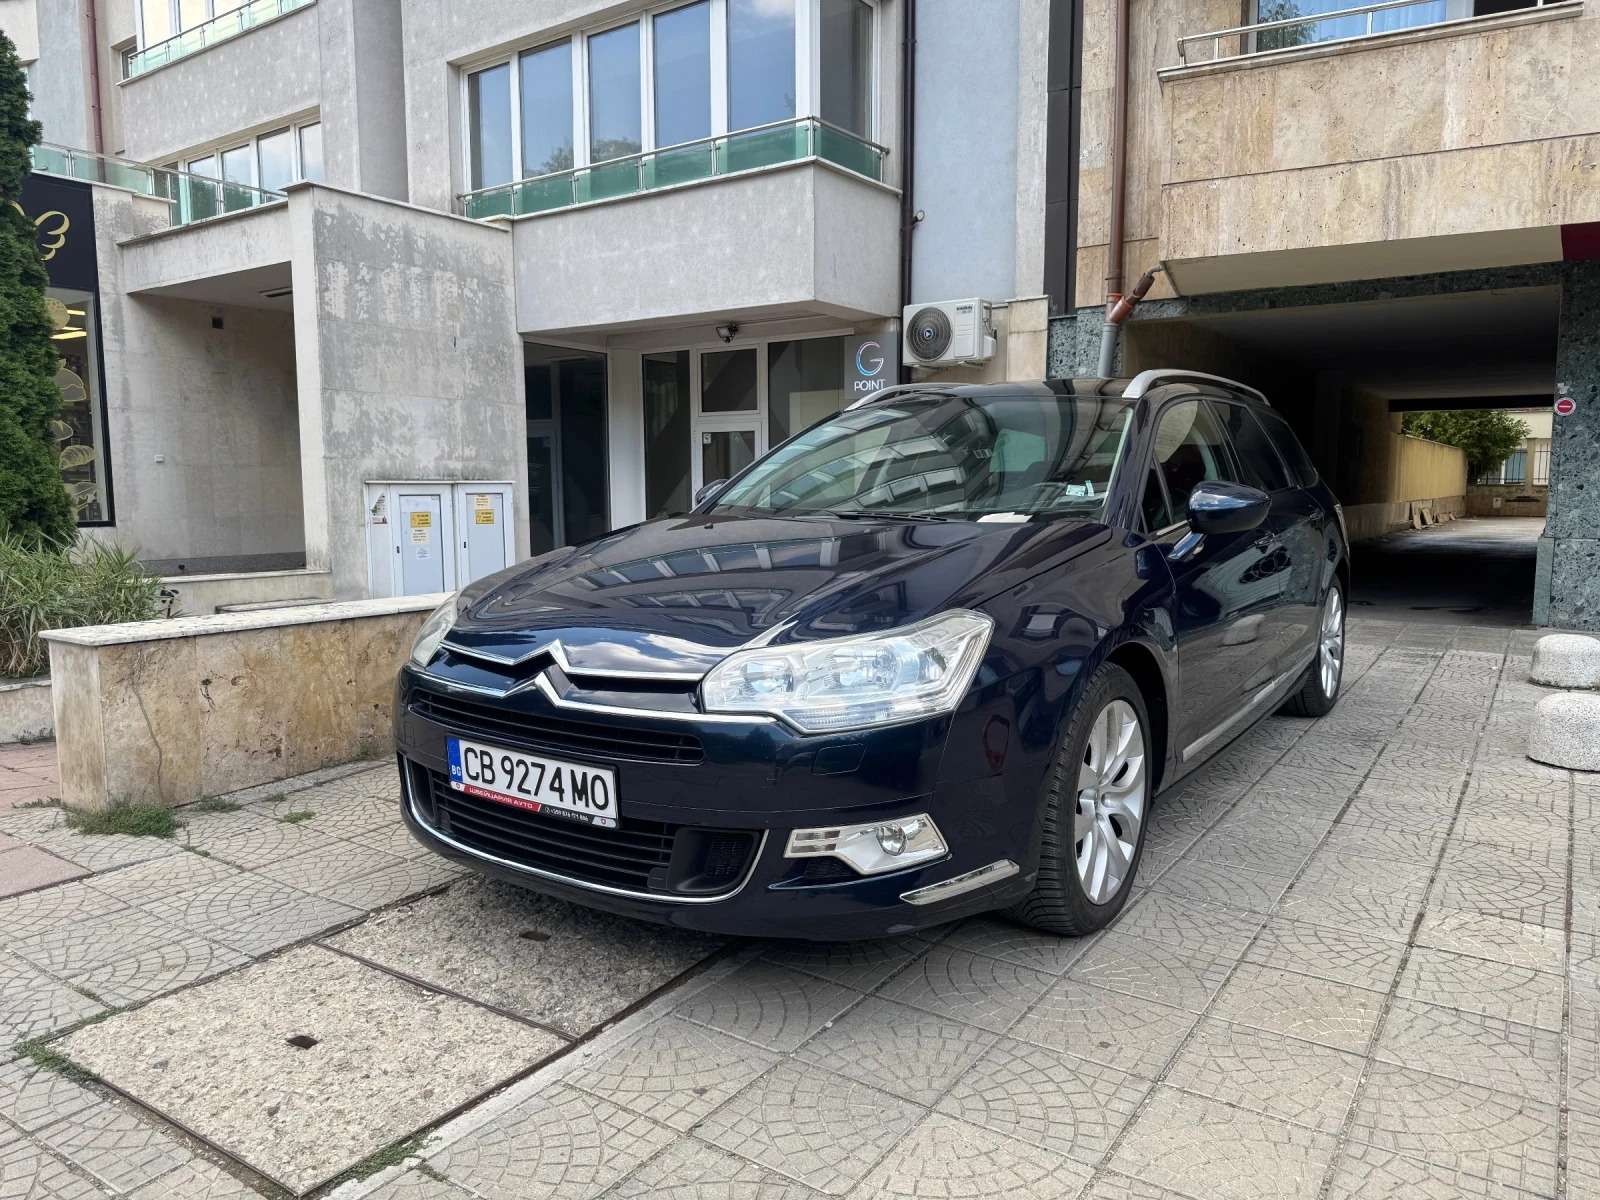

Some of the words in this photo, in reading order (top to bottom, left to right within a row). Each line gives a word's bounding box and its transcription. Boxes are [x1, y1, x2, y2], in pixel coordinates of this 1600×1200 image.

[855, 341, 884, 377] G
[854, 378, 886, 391] POINT
[451, 764, 462, 777] BG
[464, 747, 496, 785] CB
[500, 755, 565, 803] 9274
[570, 768, 609, 811] MO
